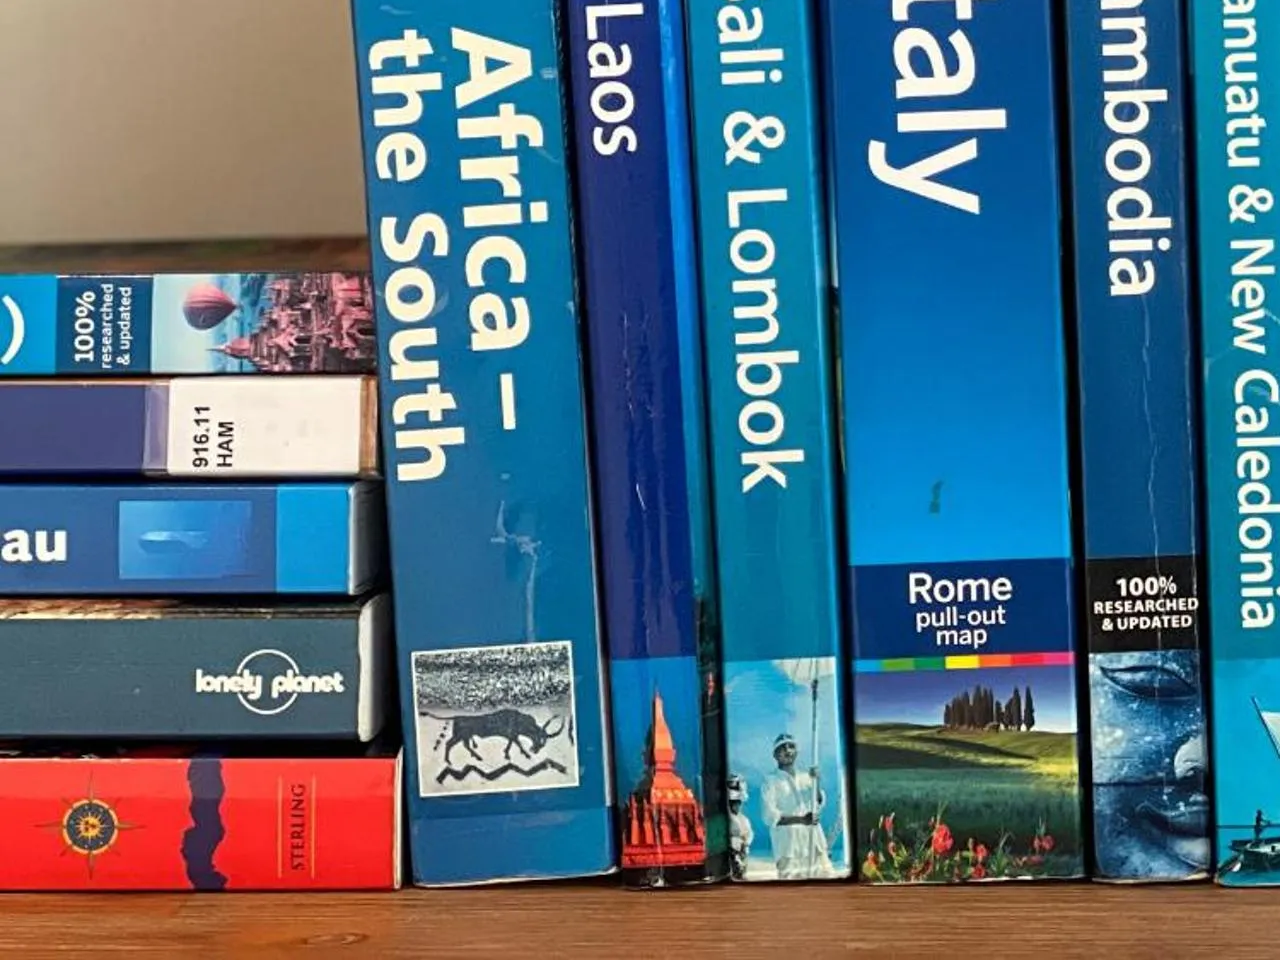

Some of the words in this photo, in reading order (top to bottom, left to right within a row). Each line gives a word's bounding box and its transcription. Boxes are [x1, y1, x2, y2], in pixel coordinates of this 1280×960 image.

[368, 29, 442, 182] the
[585, 2, 644, 156] Laos
[723, 111, 786, 165] &
[451, 27, 548, 351] Africa
[1228, 184, 1274, 222] &
[99, 282, 115, 369] researched
[118, 285, 134, 350] updated
[1230, 239, 1275, 354] New
[74, 291, 96, 362] 100%
[379, 213, 466, 482] South
[728, 188, 805, 492] Lombok
[116, 352, 131, 366] &
[192, 406, 210, 468] 916.11
[216, 421, 234, 467] HAM
[909, 572, 1013, 604] Rome
[1093, 597, 1199, 614] RESEARCHED
[1116, 575, 1177, 597] 100%
[916, 605, 1006, 633] pull-out
[936, 628, 987, 649] map
[1101, 618, 1114, 631] &
[1116, 614, 1193, 630] UPDATED
[195, 669, 262, 700] lonely
[271, 670, 345, 699] planet
[290, 783, 306, 871] STERLING
